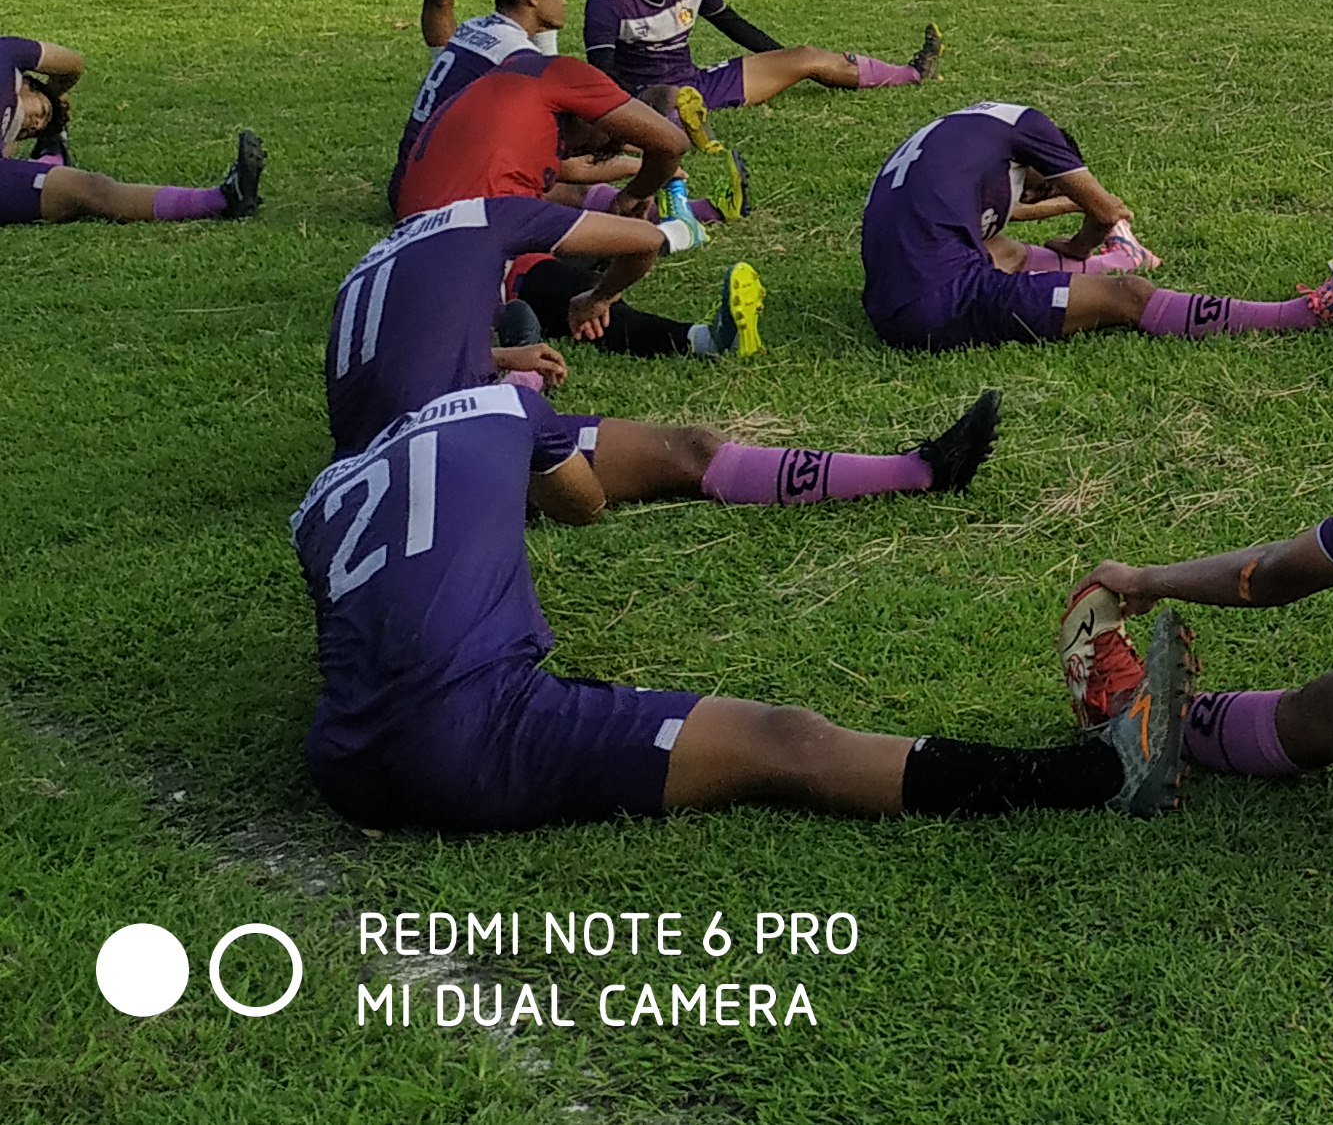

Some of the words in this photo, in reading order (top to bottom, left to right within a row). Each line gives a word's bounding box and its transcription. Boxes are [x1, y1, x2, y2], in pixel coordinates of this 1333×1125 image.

[413, 50, 456, 123] 8
[336, 256, 398, 380] 11
[412, 396, 478, 426] DIRI
[323, 430, 439, 603] 21
